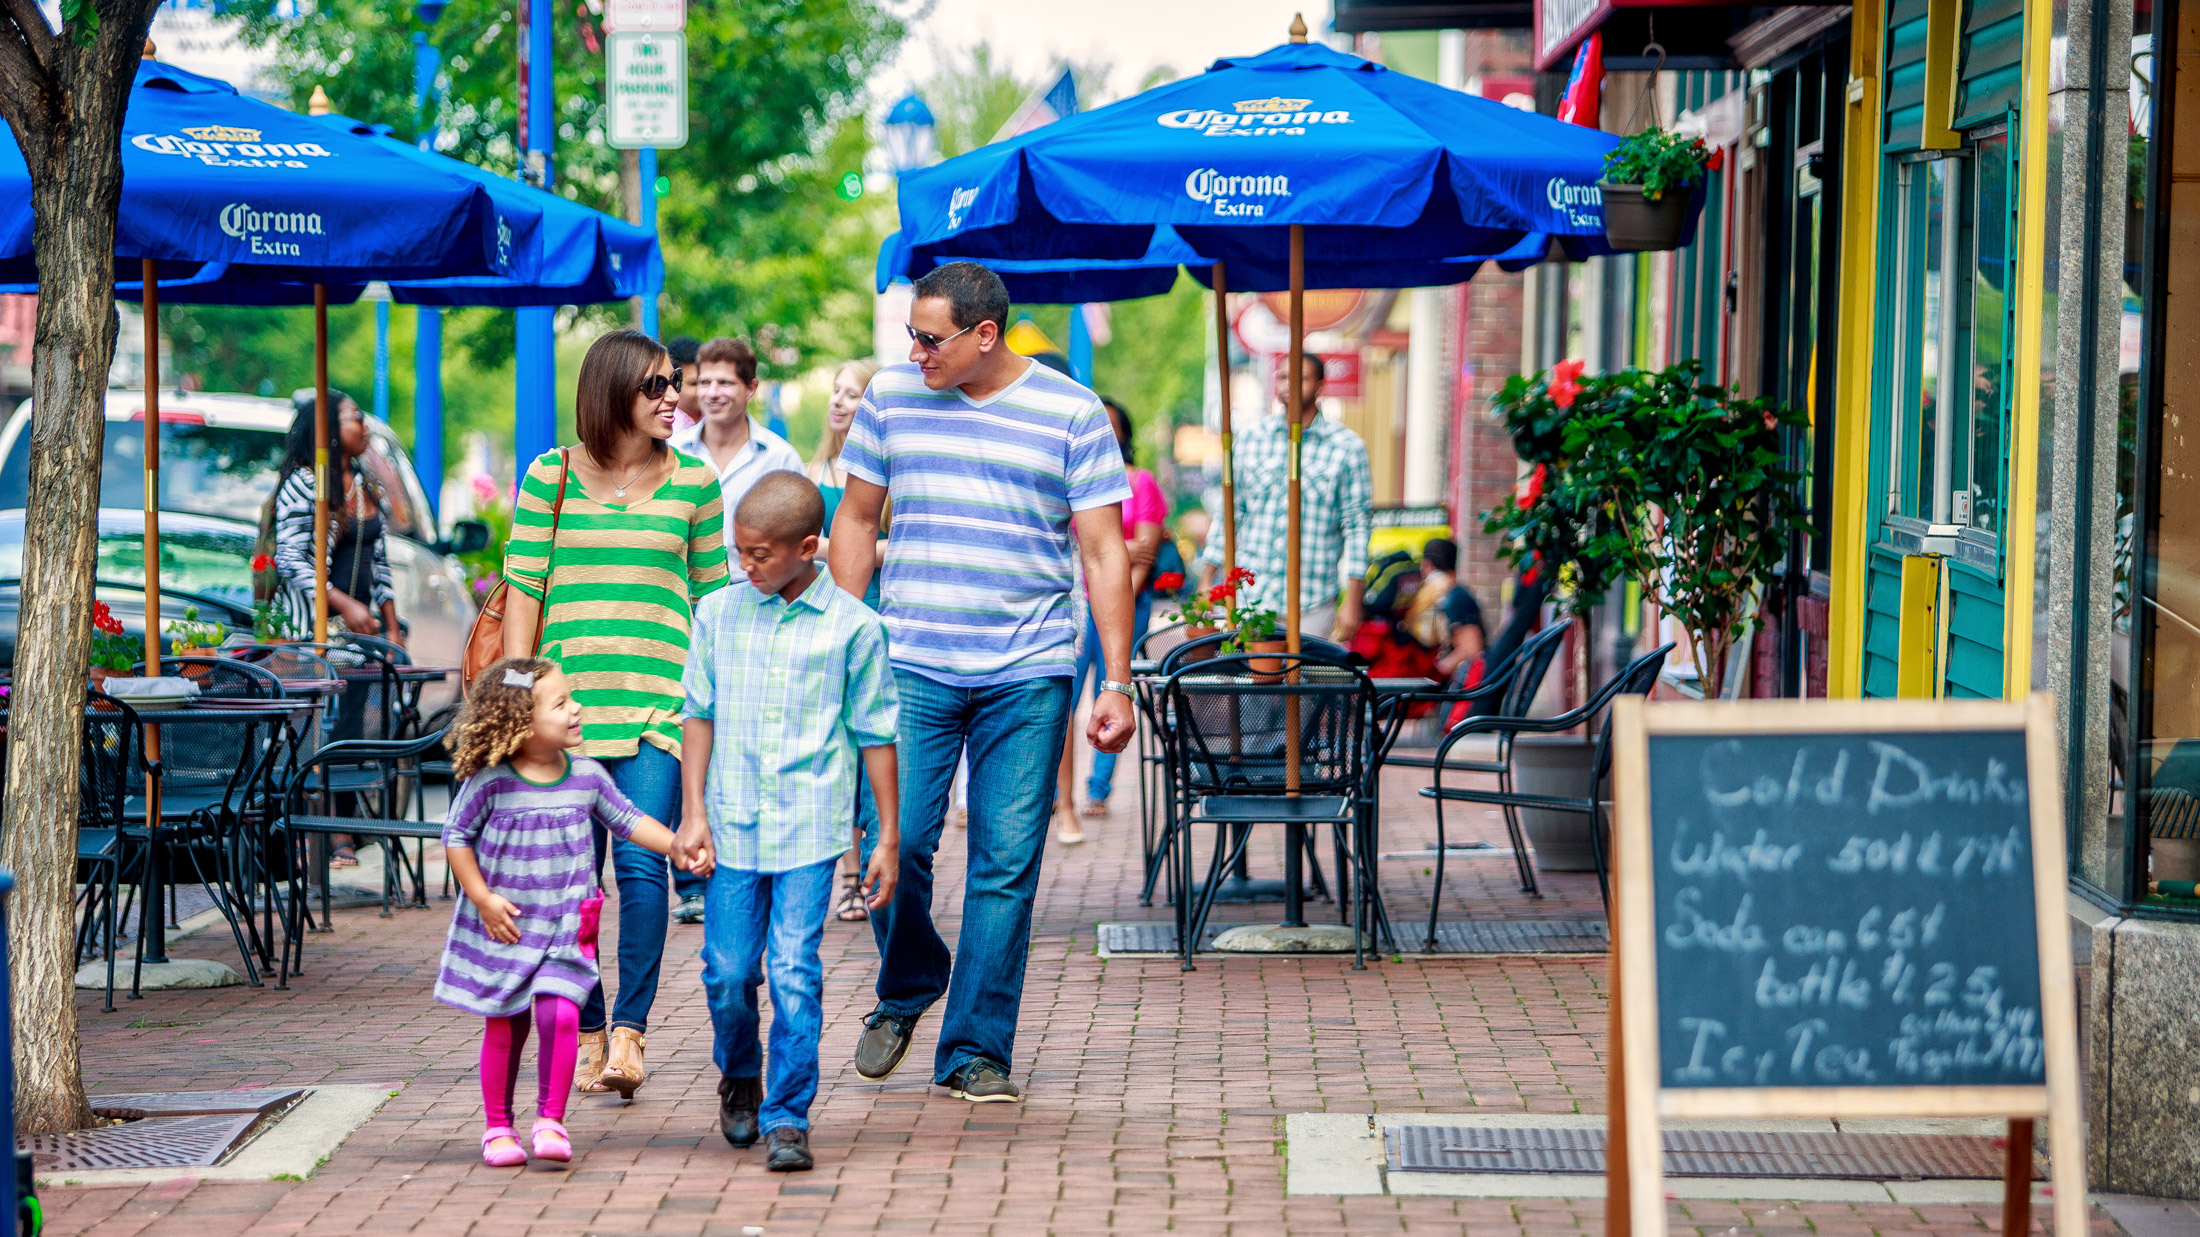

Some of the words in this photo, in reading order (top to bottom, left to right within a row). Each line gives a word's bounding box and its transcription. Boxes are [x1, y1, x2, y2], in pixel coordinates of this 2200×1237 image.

[1157, 109, 1350, 130] Corona
[1203, 123, 1306, 136] Extra
[131, 133, 332, 158] Corona
[196, 154, 309, 168] Extra
[1185, 167, 1290, 204] Corona
[1546, 177, 1602, 213] Coron
[219, 203, 323, 241] Corona
[1213, 198, 1264, 217] Extra
[250, 235, 301, 257] Extra
[1702, 739, 1849, 806] Cold
[1867, 739, 2026, 815] Drinks
[1664, 886, 1767, 950] Soda
[1783, 923, 1848, 952] can
[1754, 955, 1872, 1009] bottle
